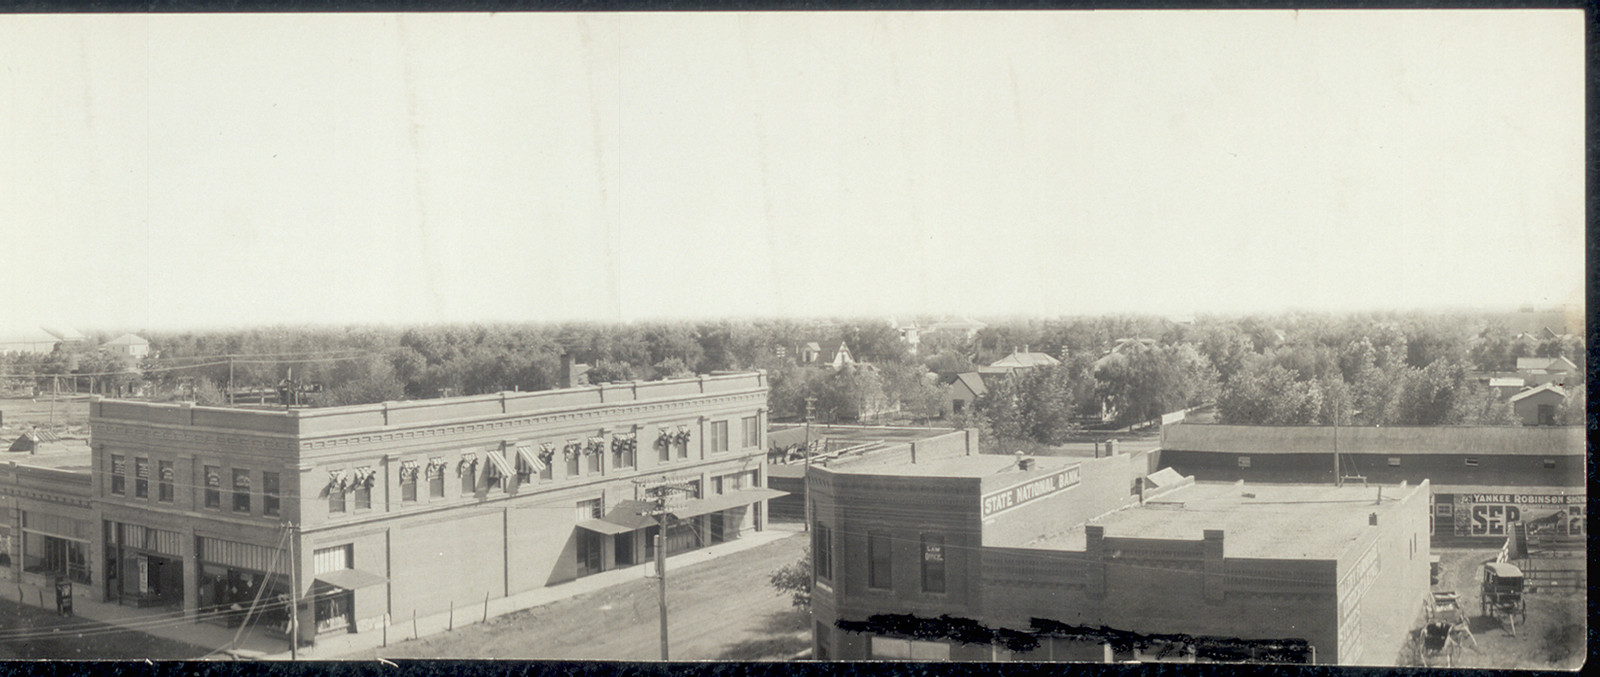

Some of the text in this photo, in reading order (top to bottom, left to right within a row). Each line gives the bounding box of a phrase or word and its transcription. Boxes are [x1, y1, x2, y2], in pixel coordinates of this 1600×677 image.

[984, 491, 1013, 514] STATE
[1016, 477, 1056, 504] NATIONAL
[1473, 494, 1511, 503] YANKEE
[1514, 495, 1564, 504] ROBINSON
[926, 545, 941, 553] LAW
